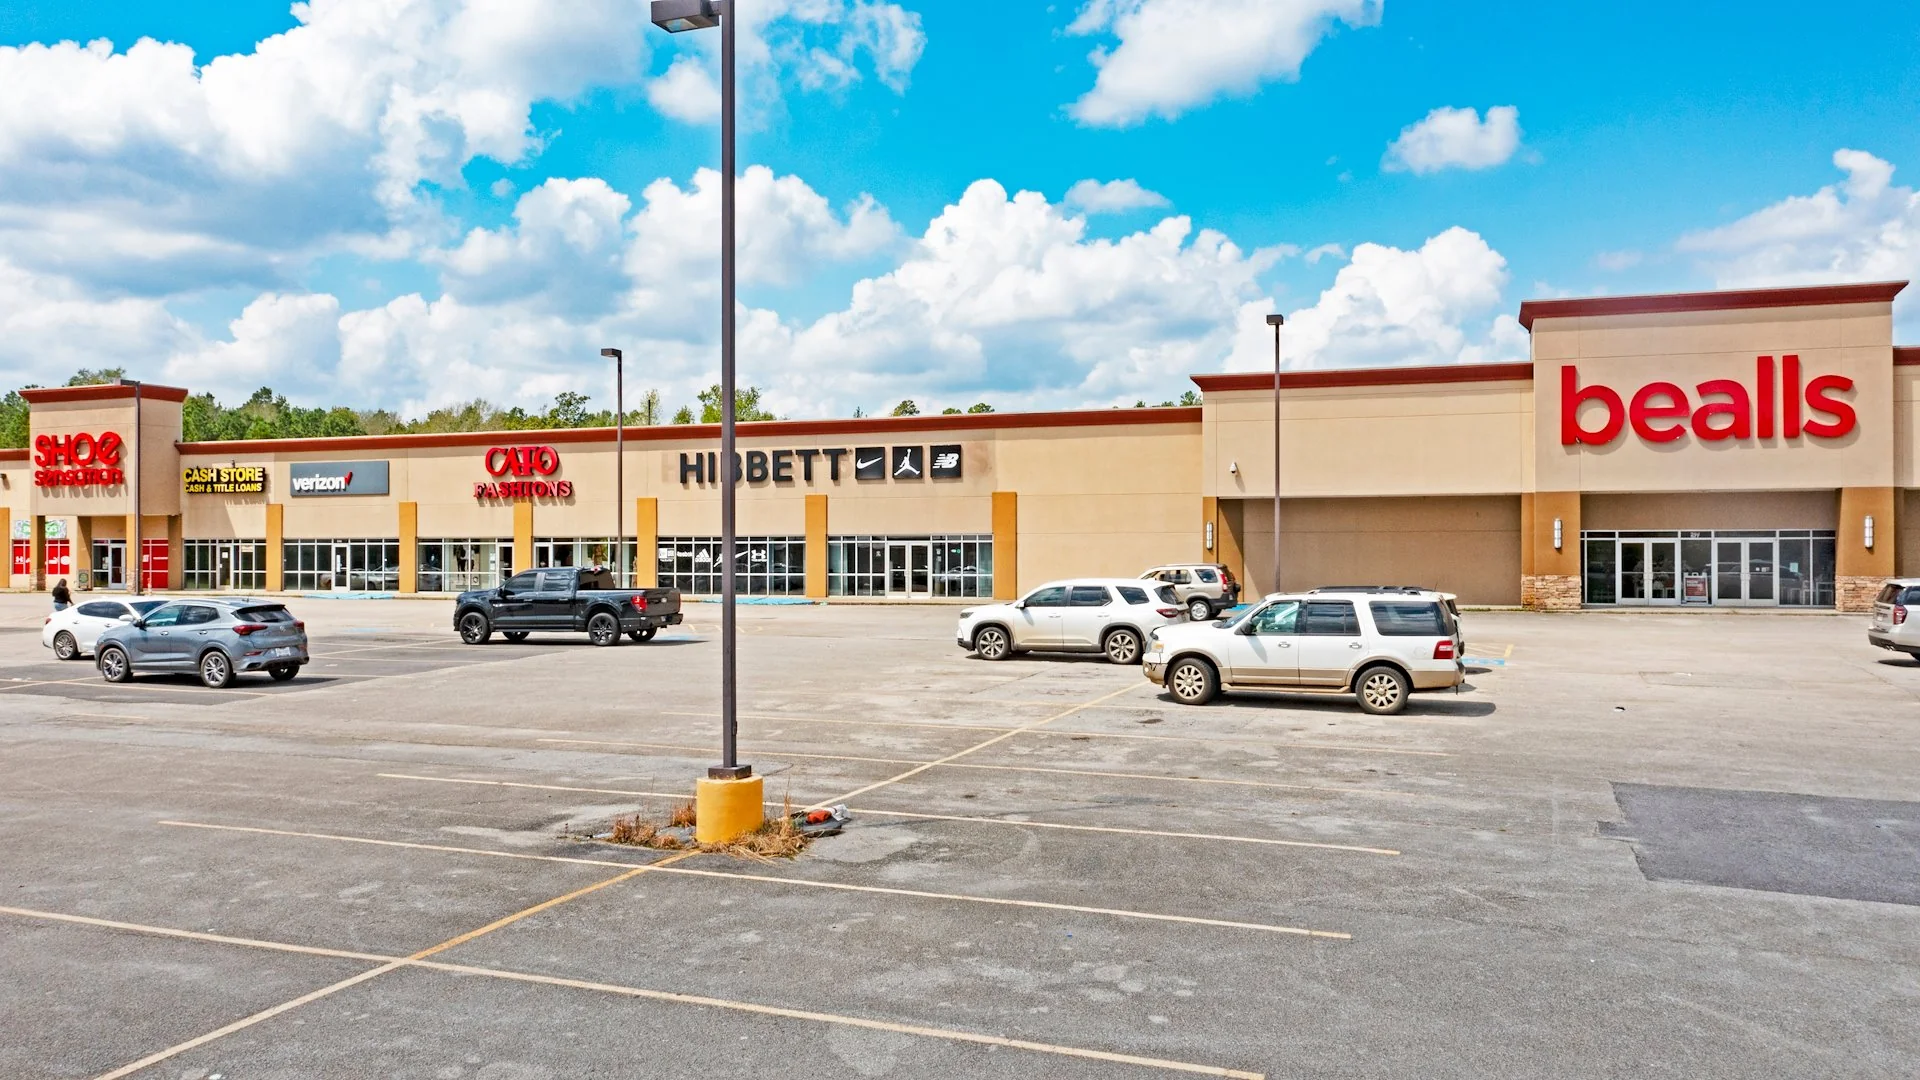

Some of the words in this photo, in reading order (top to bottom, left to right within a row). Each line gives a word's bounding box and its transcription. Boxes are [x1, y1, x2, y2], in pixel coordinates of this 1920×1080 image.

[1561, 354, 1857, 446] bealls
[485, 446, 559, 476] CATO
[183, 468, 217, 483] CASH
[220, 467, 264, 482] STORE
[292, 473, 346, 491] verizon
[184, 484, 205, 493] CASH
[206, 484, 213, 493] &
[213, 483, 235, 493] TITLE
[235, 483, 262, 492] LOANS
[473, 480, 573, 499] FASHIONS
